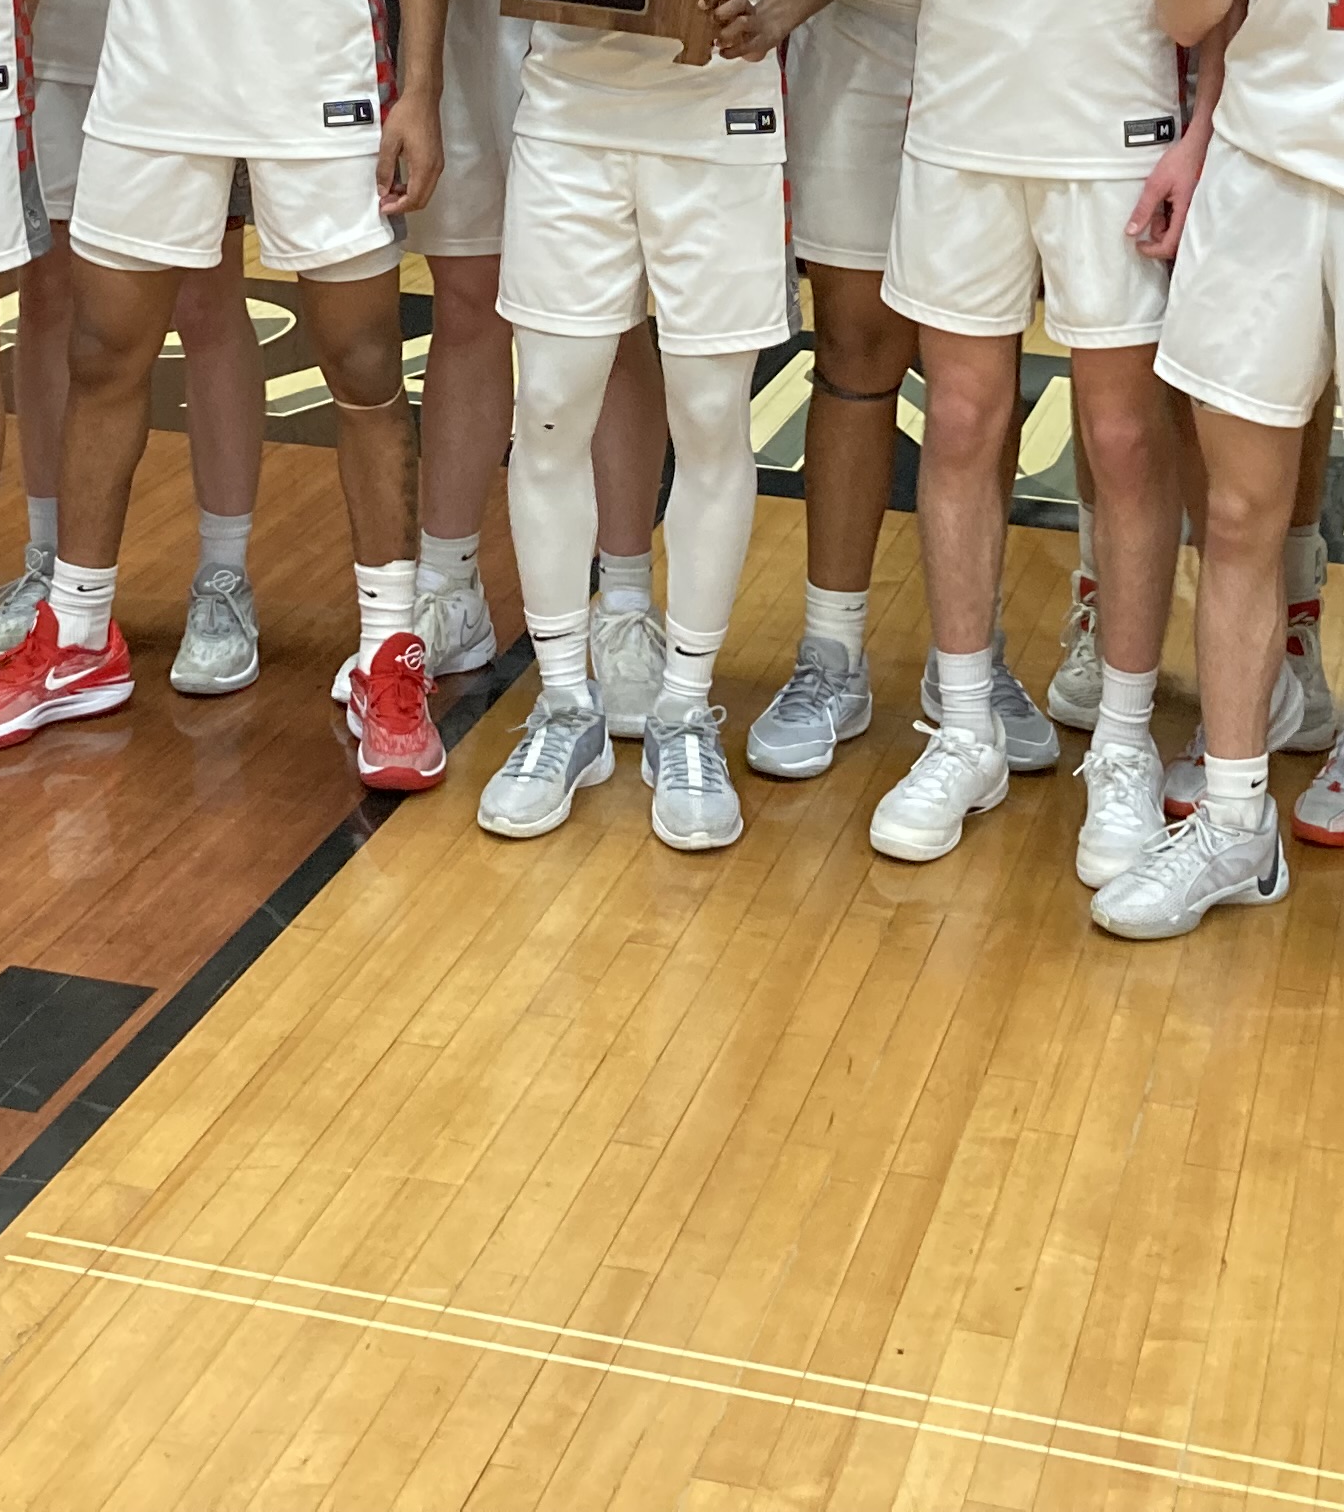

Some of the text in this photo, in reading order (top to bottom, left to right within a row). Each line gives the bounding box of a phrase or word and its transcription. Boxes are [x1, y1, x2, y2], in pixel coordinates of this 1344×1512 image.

[359, 106, 367, 118] L
[761, 115, 771, 126] M
[1160, 124, 1169, 136] M
